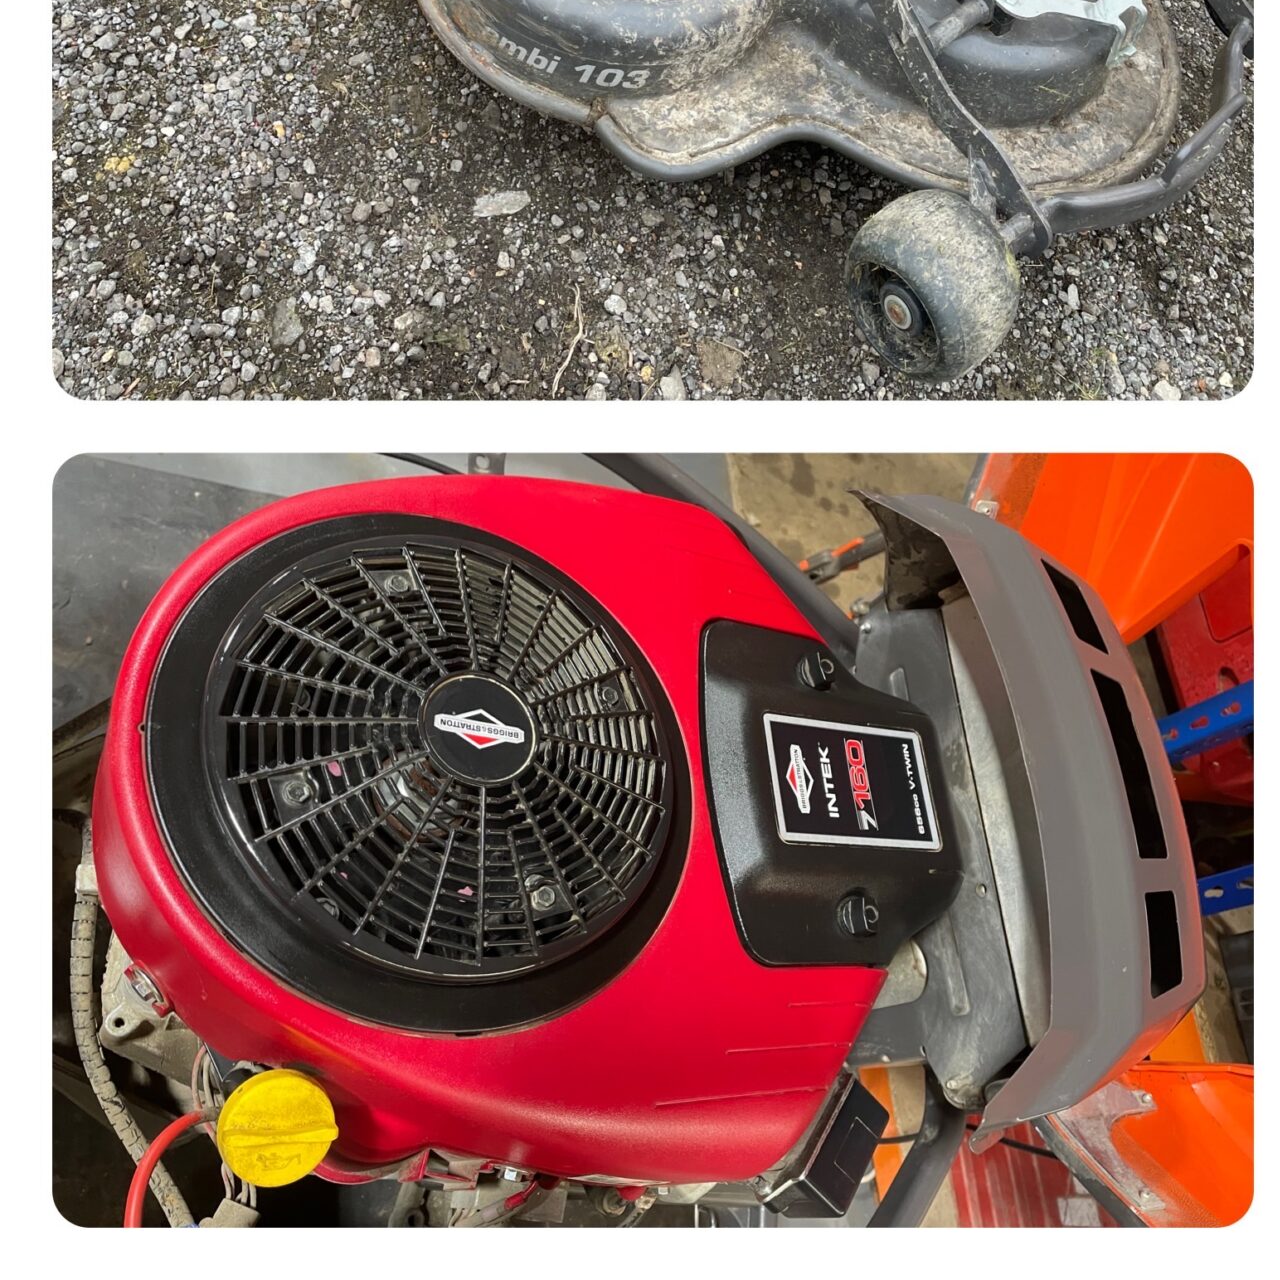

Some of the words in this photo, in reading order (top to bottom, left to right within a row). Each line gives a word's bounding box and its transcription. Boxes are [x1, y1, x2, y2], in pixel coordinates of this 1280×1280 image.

[486, 26, 562, 75] mbi
[574, 64, 651, 89] 103
[818, 745, 841, 818] INTEK
[845, 739, 879, 831] 7160
